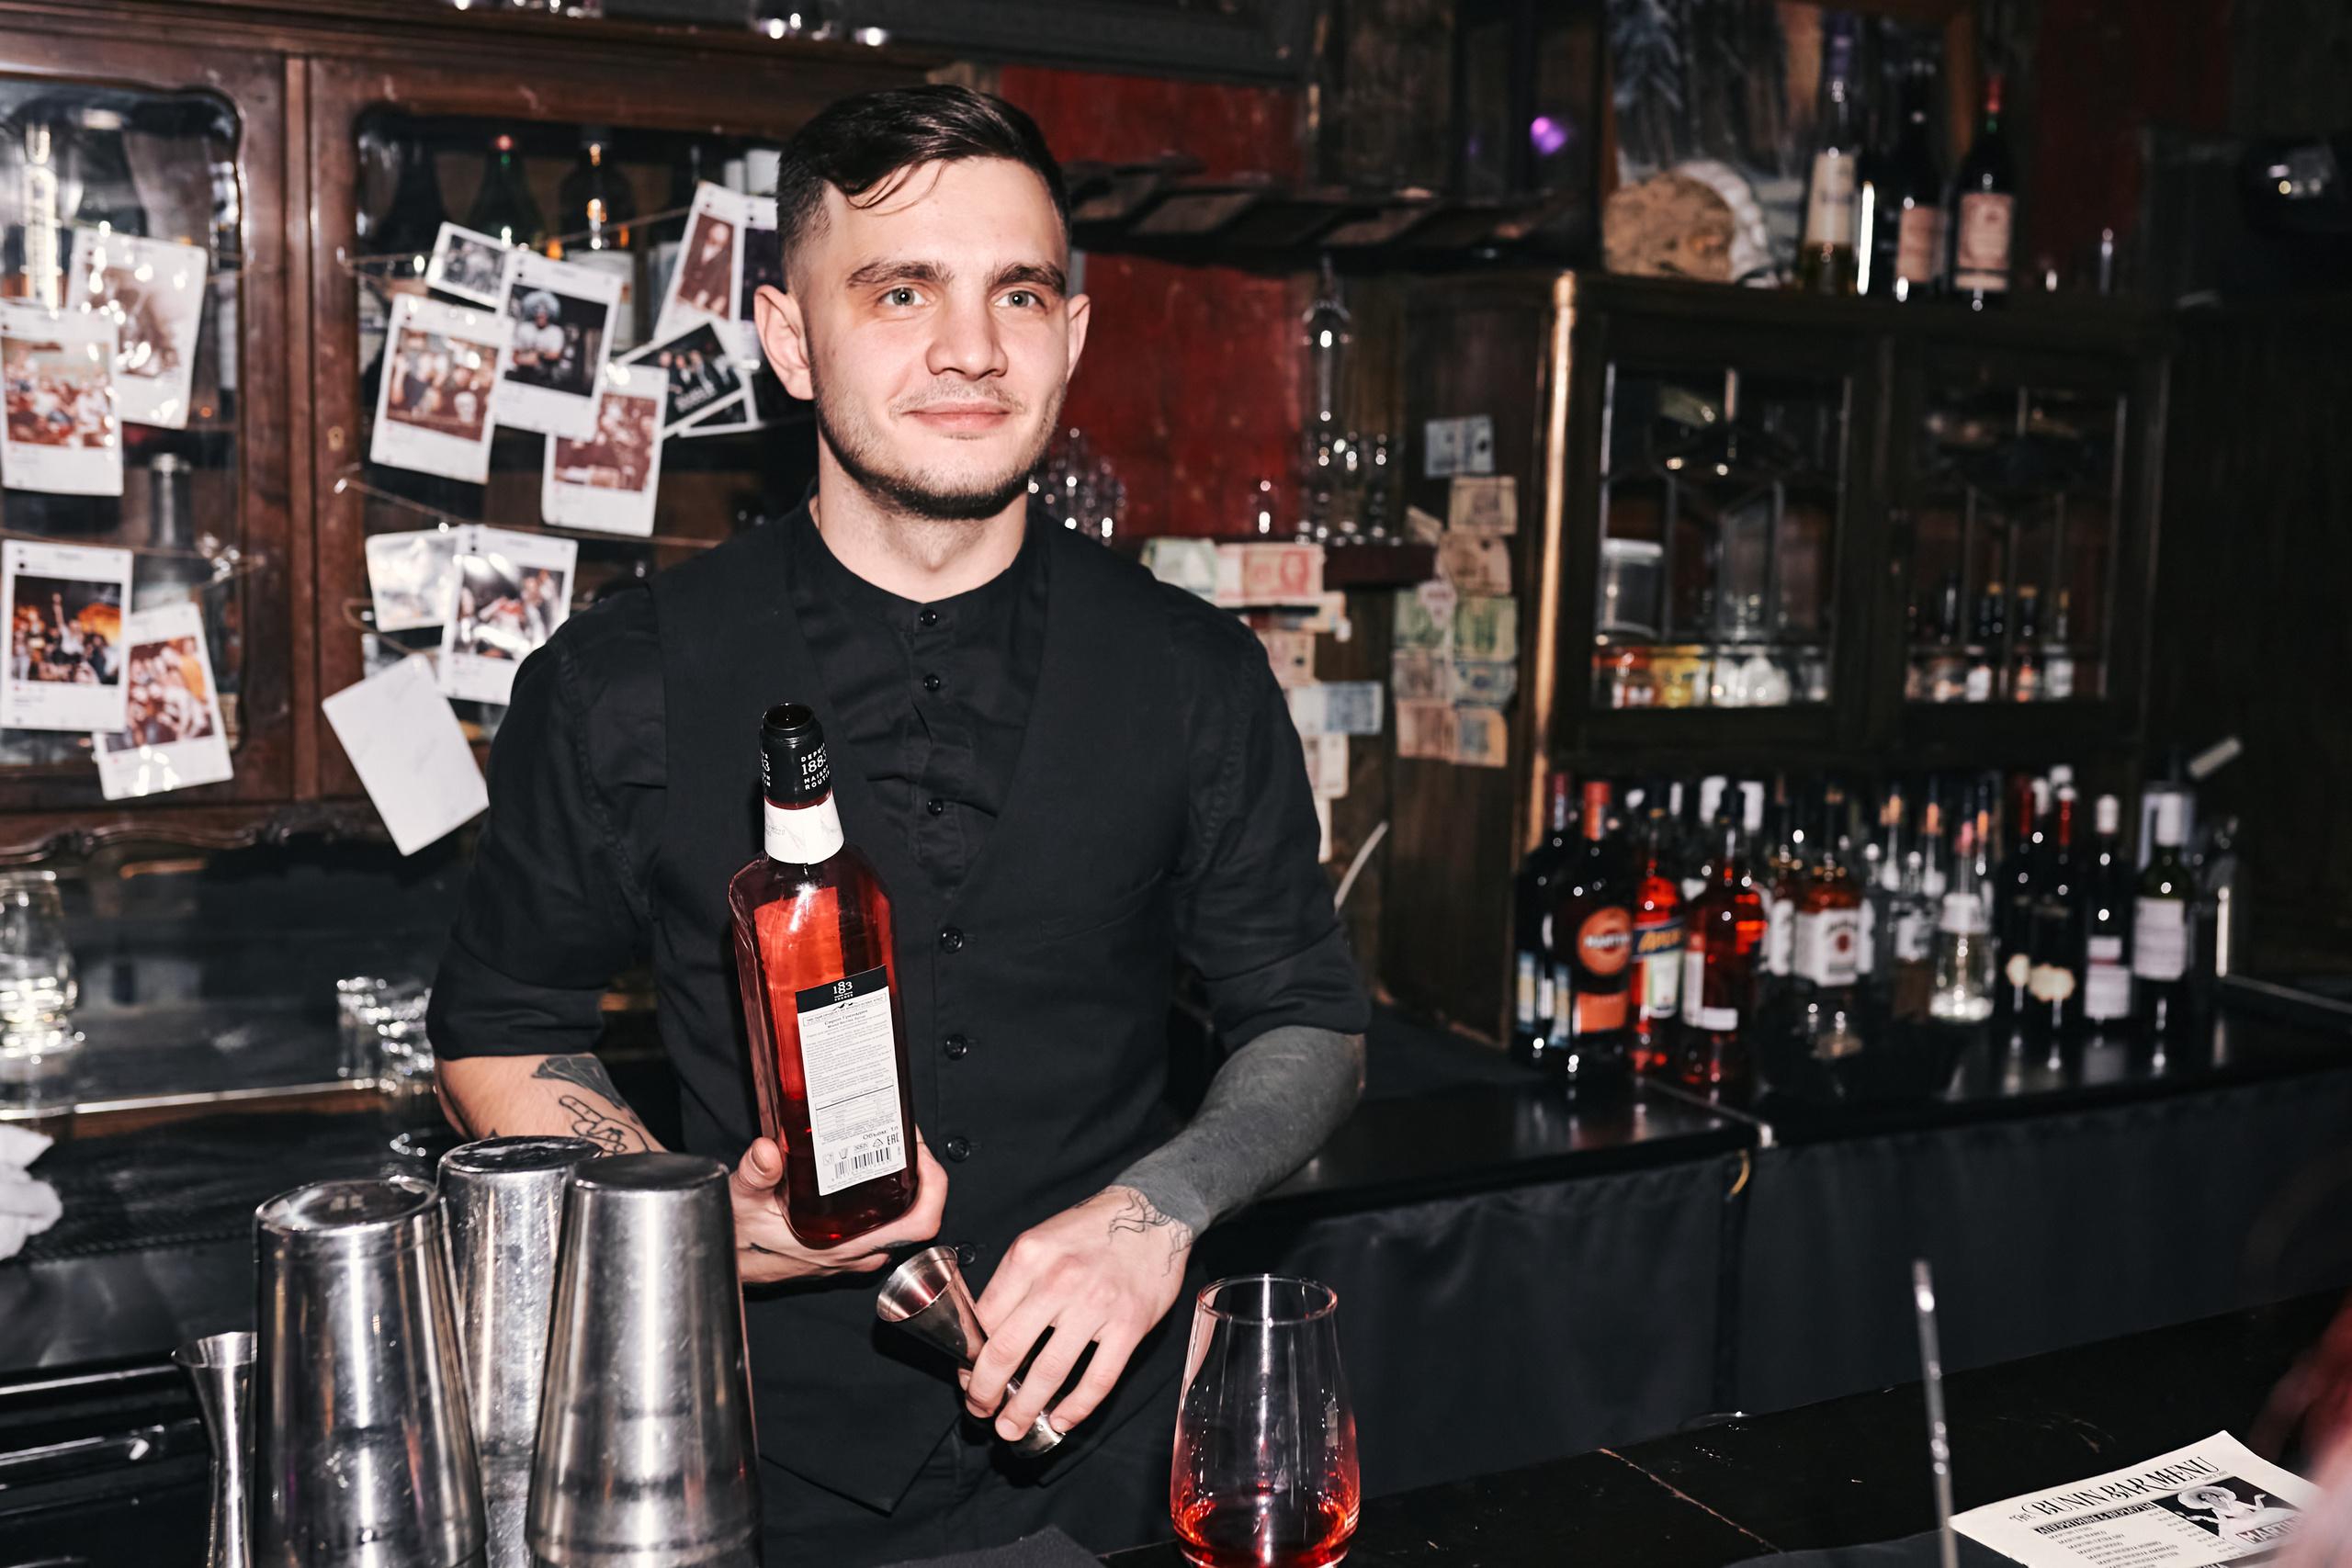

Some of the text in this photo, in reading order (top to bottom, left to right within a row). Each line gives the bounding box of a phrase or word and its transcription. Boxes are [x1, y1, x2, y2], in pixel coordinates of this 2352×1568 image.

[2021, 1489, 2105, 1515] BUNIN
[2099, 1476, 2165, 1500] BAR
[2145, 1456, 2219, 1488] MENU
[2238, 1516, 2302, 1544] MARTIN
